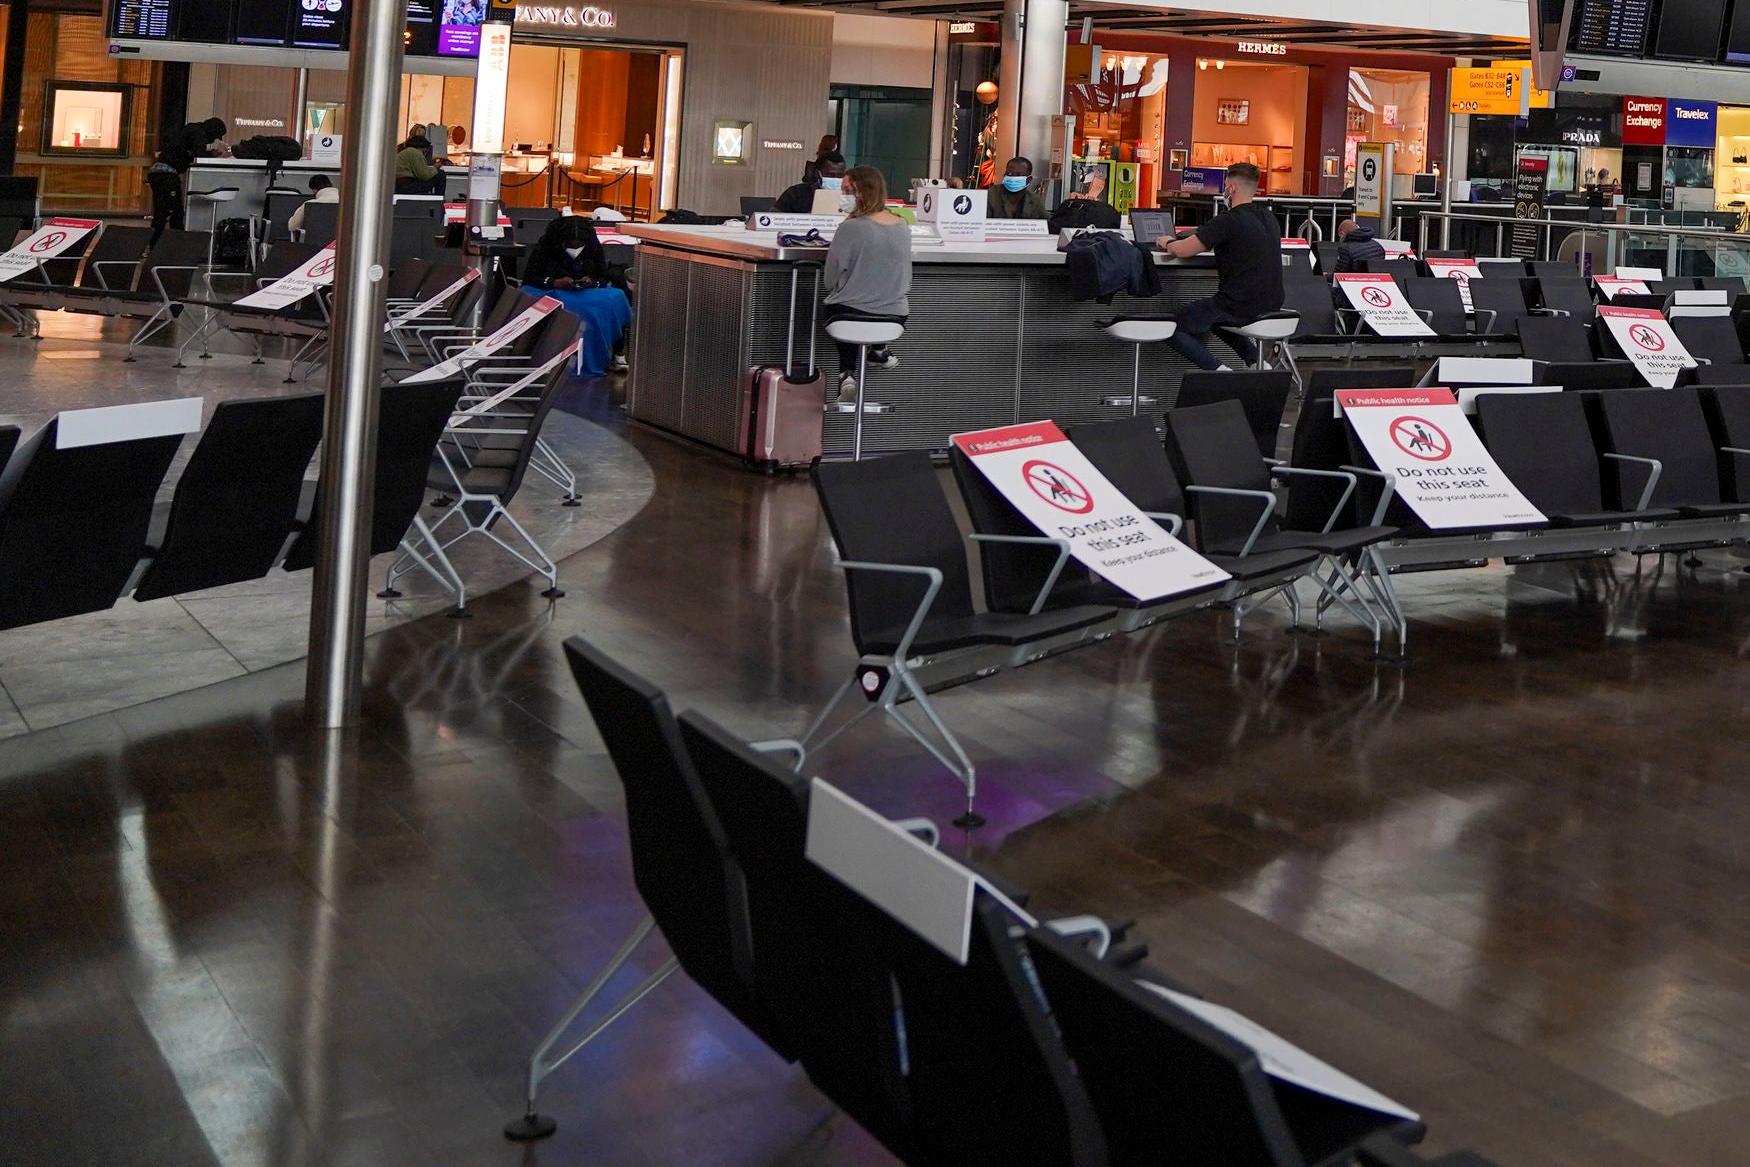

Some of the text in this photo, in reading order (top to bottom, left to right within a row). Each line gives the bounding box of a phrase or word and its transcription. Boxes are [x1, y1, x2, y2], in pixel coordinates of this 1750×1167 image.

[514, 5, 560, 23] FANY
[562, 6, 577, 26] &
[1237, 41, 1287, 55] HERMÈS
[1627, 100, 1663, 114] Currency
[1675, 107, 1709, 120] Travelex
[235, 117, 264, 126] TIFFANY
[1626, 115, 1662, 129] Exchange
[1562, 132, 1600, 143] PRADA
[763, 140, 787, 148] TIFFANY
[1184, 169, 1204, 180] Currency
[1519, 174, 1532, 183] Flying
[1183, 180, 1204, 190] Exchange
[1634, 353, 1650, 361] Do
[1651, 353, 1667, 361] not
[1381, 397, 1406, 405] health
[975, 434, 1043, 451] Public health notice
[1396, 465, 1488, 477] Do not use
[1416, 478, 1490, 490] this seat
[1416, 491, 1510, 502] Keep your distance
[1058, 514, 1140, 539] Do not use
[1087, 530, 1153, 552] this seat
[1100, 545, 1178, 570] Keep your distance
